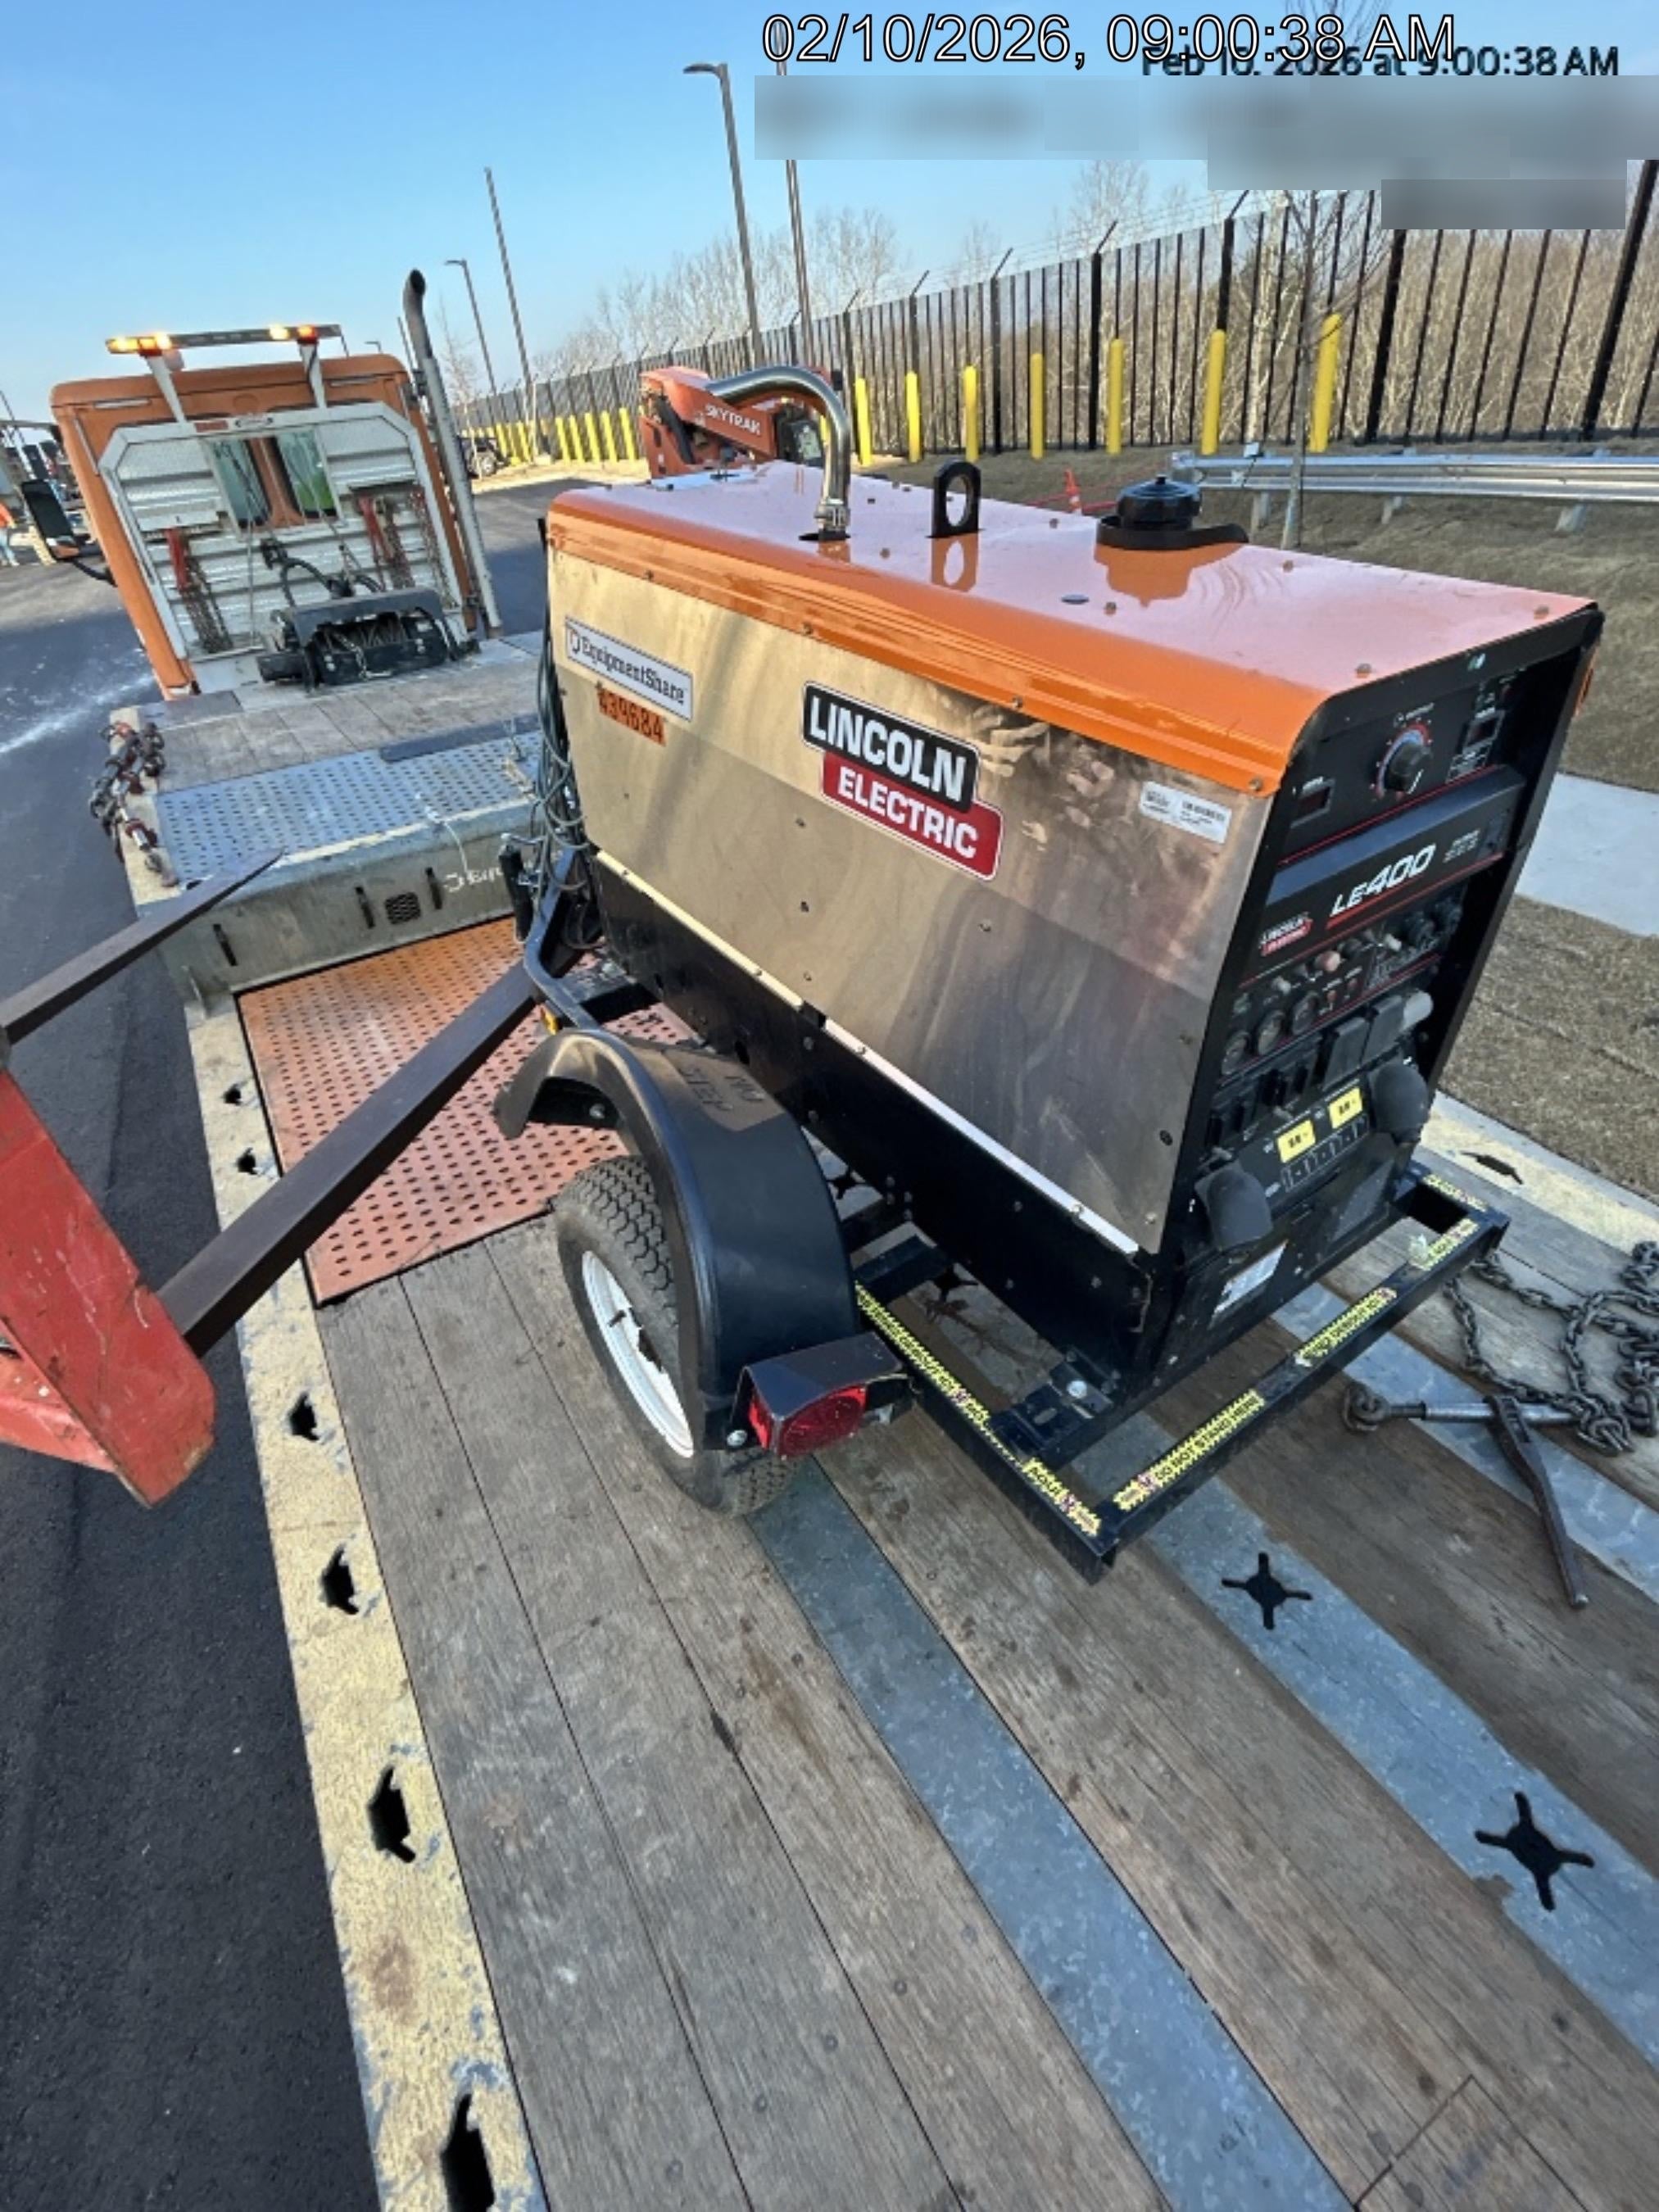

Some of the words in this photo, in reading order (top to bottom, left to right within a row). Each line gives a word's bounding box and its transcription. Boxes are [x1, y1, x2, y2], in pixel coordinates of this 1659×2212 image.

[705, 404, 762, 436] SKYTRAK
[581, 636, 684, 705] EquipmentShare
[809, 695, 968, 803] LINCOLN
[836, 765, 979, 859] ELECTRIC
